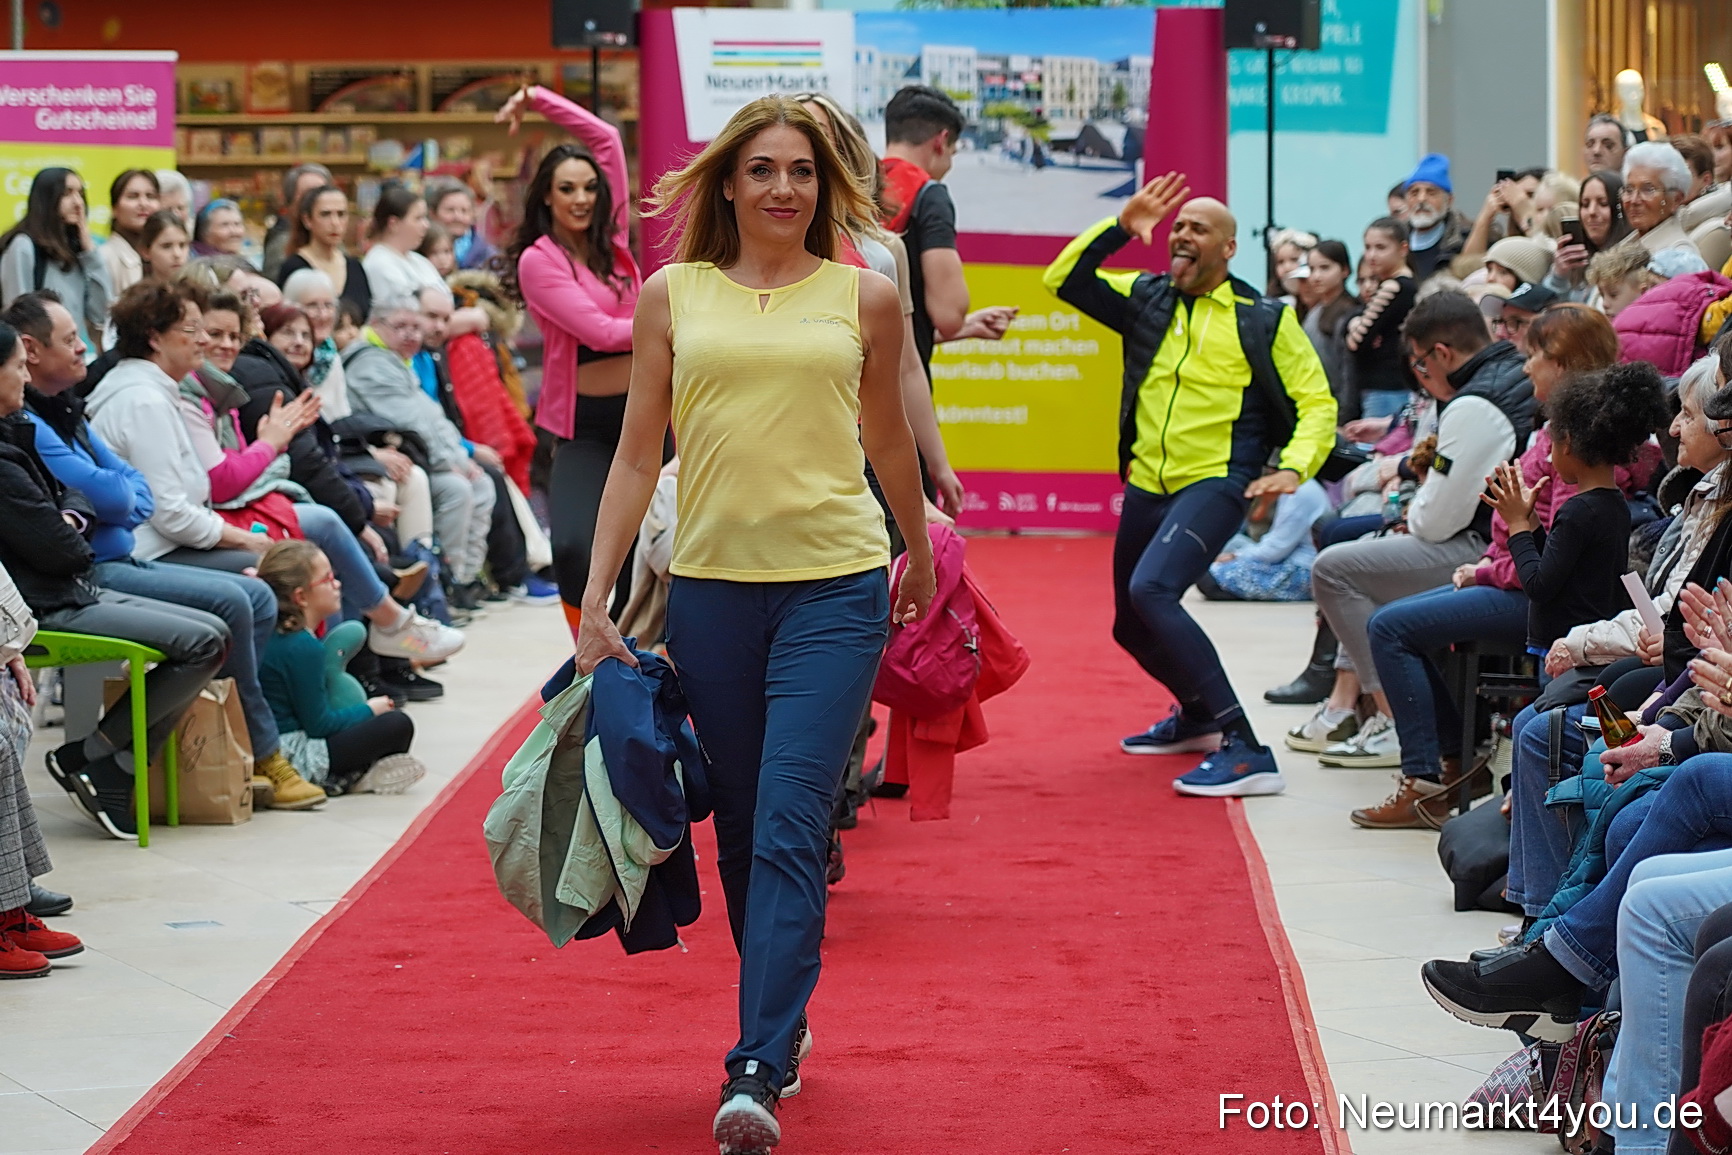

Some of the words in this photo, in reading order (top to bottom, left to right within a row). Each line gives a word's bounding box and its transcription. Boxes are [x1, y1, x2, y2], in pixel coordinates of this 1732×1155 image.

[123, 83, 157, 107] Sie
[35, 107, 157, 130] Gutscheine!
[1049, 311, 1080, 331] Ort
[1006, 360, 1083, 381] buchen.
